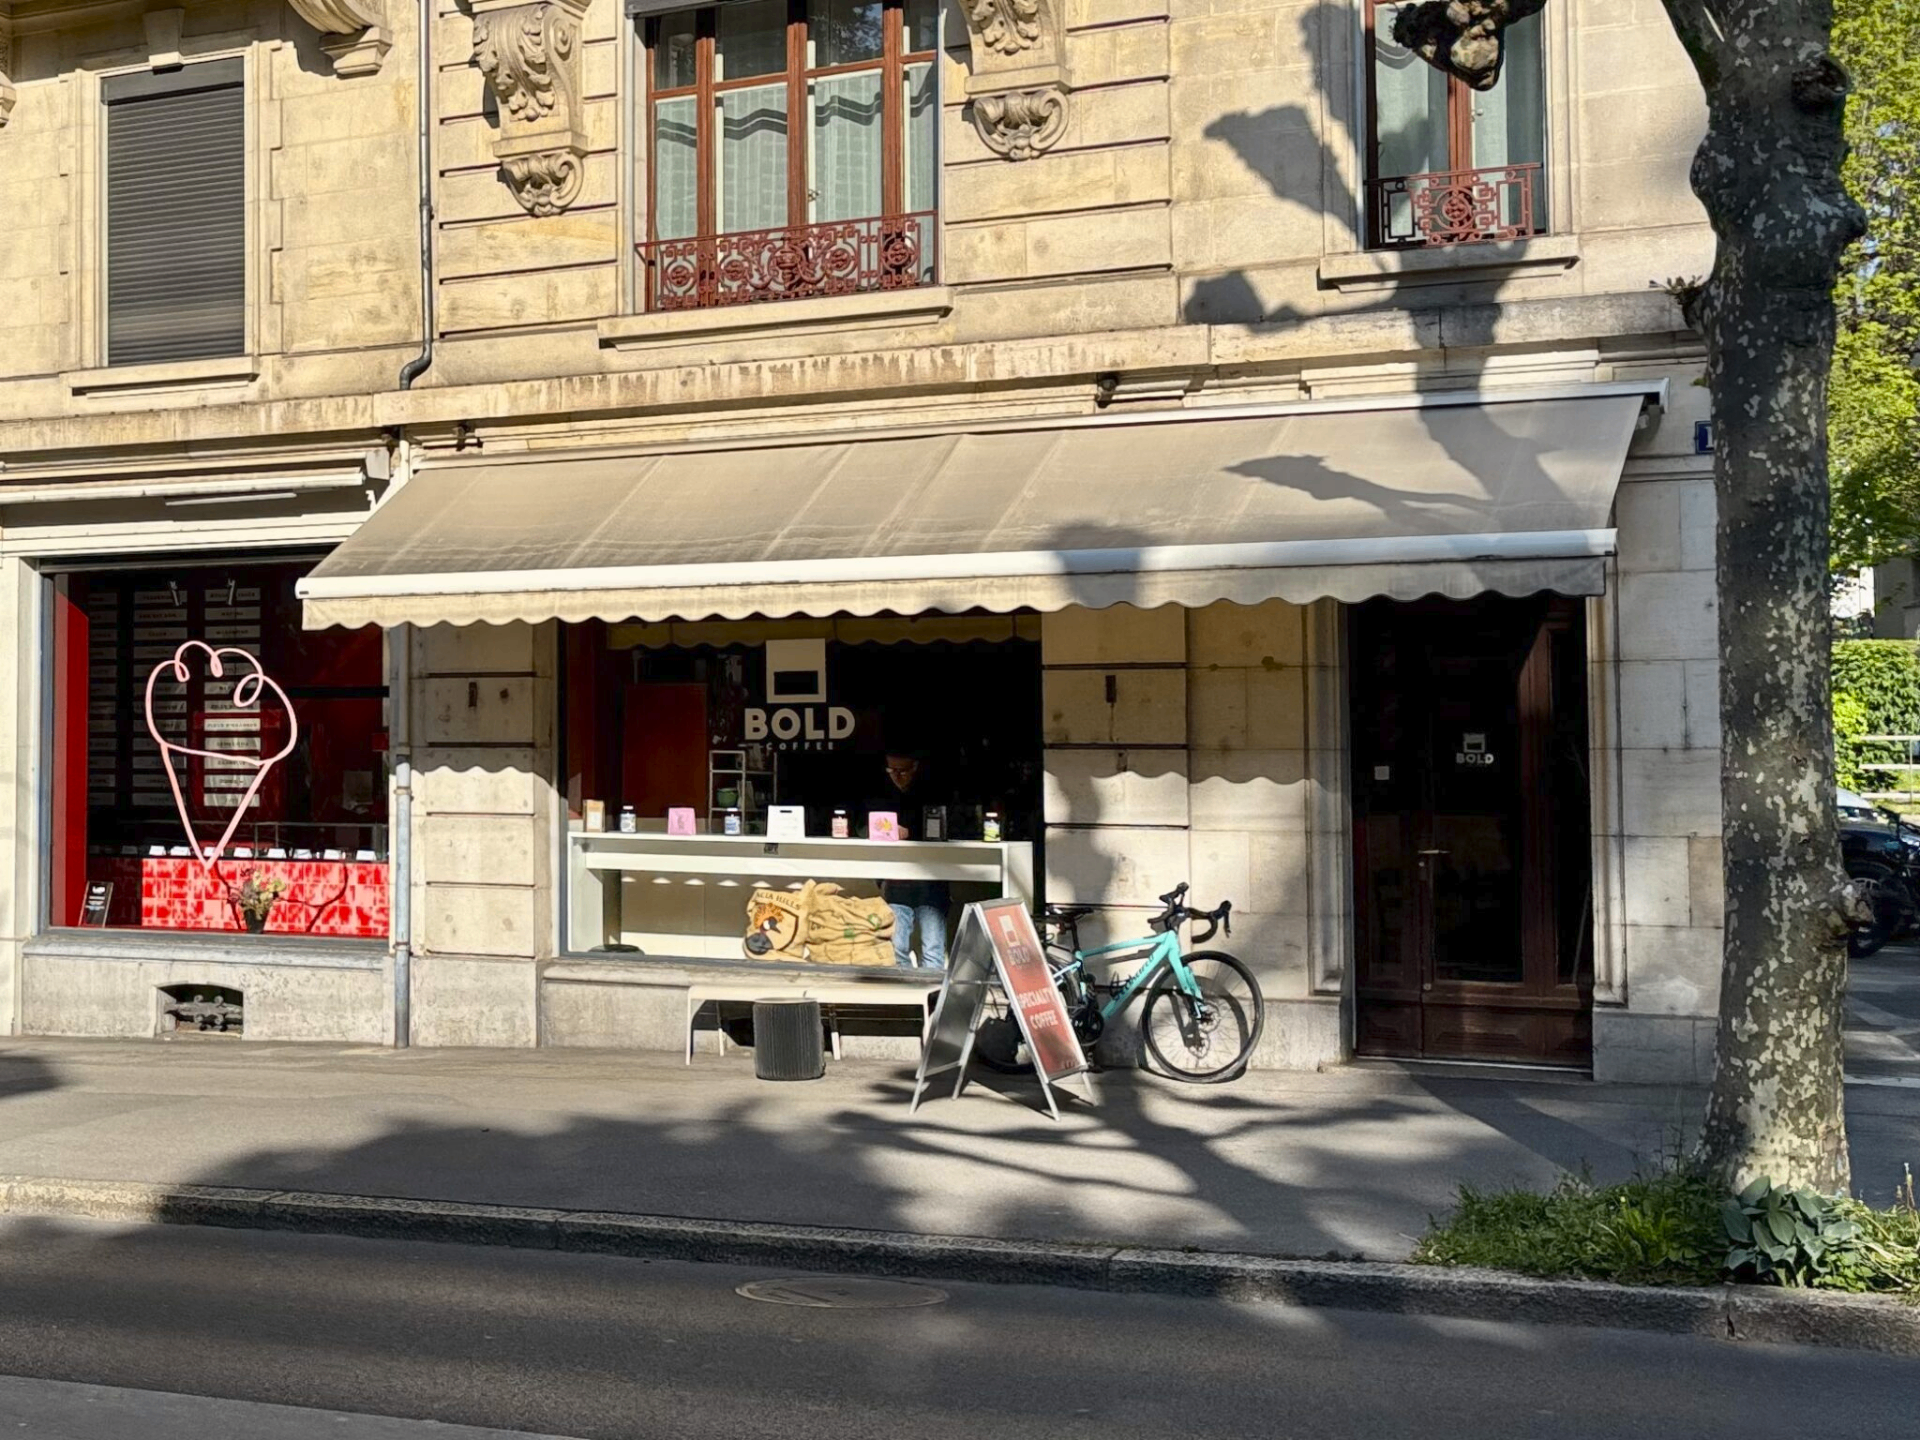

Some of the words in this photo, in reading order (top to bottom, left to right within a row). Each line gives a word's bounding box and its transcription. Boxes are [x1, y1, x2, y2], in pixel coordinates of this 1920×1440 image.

[744, 706, 856, 740] BOLD
[766, 741, 834, 750] COFFEE
[1455, 752, 1494, 765] BOLD
[1018, 986, 1056, 1009] SPECIALTY
[1030, 1010, 1059, 1030] COFFEE
